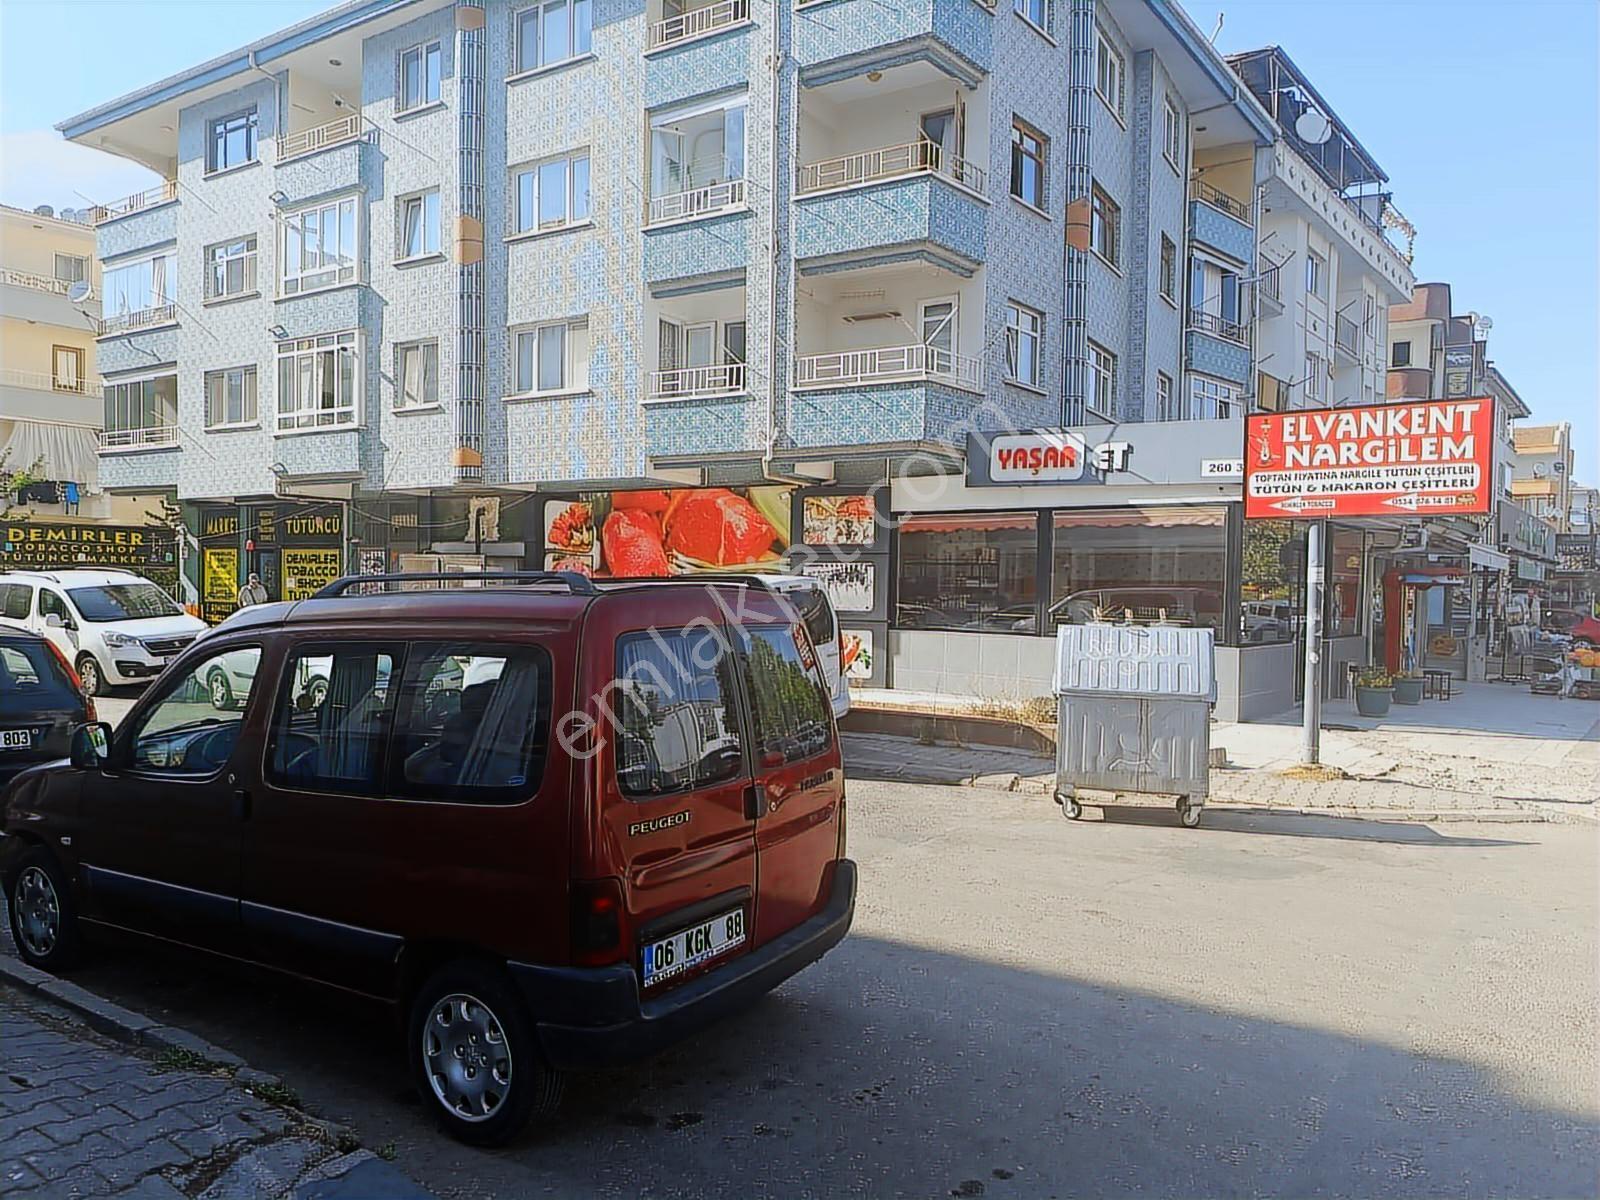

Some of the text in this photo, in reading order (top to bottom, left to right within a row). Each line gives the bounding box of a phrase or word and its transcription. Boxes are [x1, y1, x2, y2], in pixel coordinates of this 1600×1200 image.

[1282, 404, 1480, 443] ELVANKENT
[998, 444, 1076, 475] YAŞAR
[1209, 463, 1232, 473] 260
[1255, 473, 1292, 483] TOPTAN
[1254, 484, 1302, 495] TÜTÜN
[1306, 484, 1317, 492] &
[1321, 480, 1397, 491] MAKARON
[8, 527, 144, 546] DEMİRLER
[14, 543, 137, 554] TOBACCO SHOP
[87, 556, 147, 564] MARKET
[286, 566, 338, 577] TOBACCO
[3, 731, 29, 746] 803
[629, 811, 691, 836] PEUGEOT
[654, 940, 675, 971] 06
[685, 923, 713, 959] KGK
